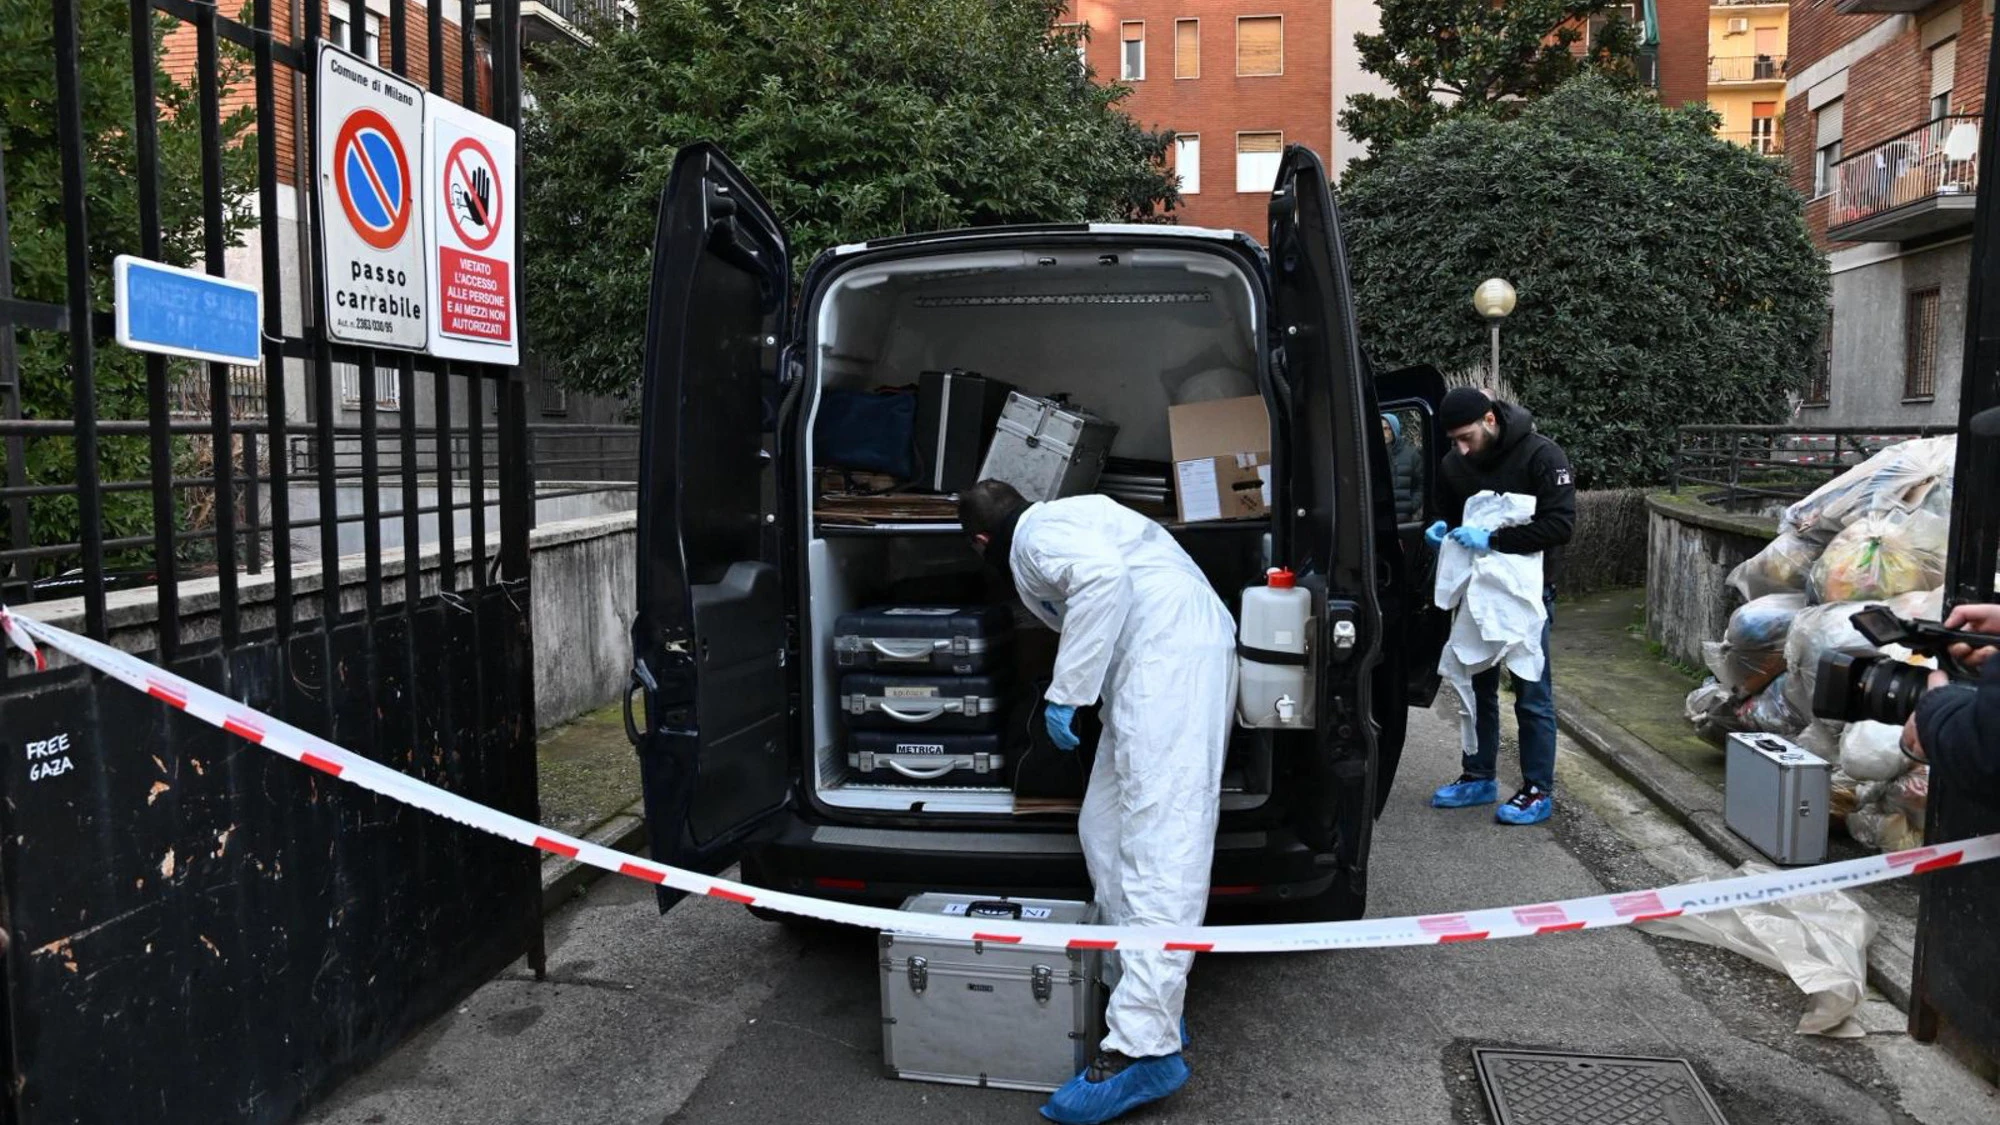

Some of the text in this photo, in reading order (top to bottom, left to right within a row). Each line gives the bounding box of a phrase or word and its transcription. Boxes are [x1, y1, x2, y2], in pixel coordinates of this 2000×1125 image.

[331, 59, 413, 106] Comune di Milano
[351, 260, 406, 287] passo
[460, 258, 491, 275] VIETATO
[454, 272, 497, 291] L'ACCESSO
[336, 289, 420, 320] carrabile
[447, 286, 505, 307] ALLE PERSONE
[447, 300, 506, 322] E AI MEZZI NON
[452, 317, 502, 336] AUTORIZZATI
[26, 733, 70, 760] FREE
[898, 745, 943, 755] METRICA
[30, 757, 74, 781] GAZA
